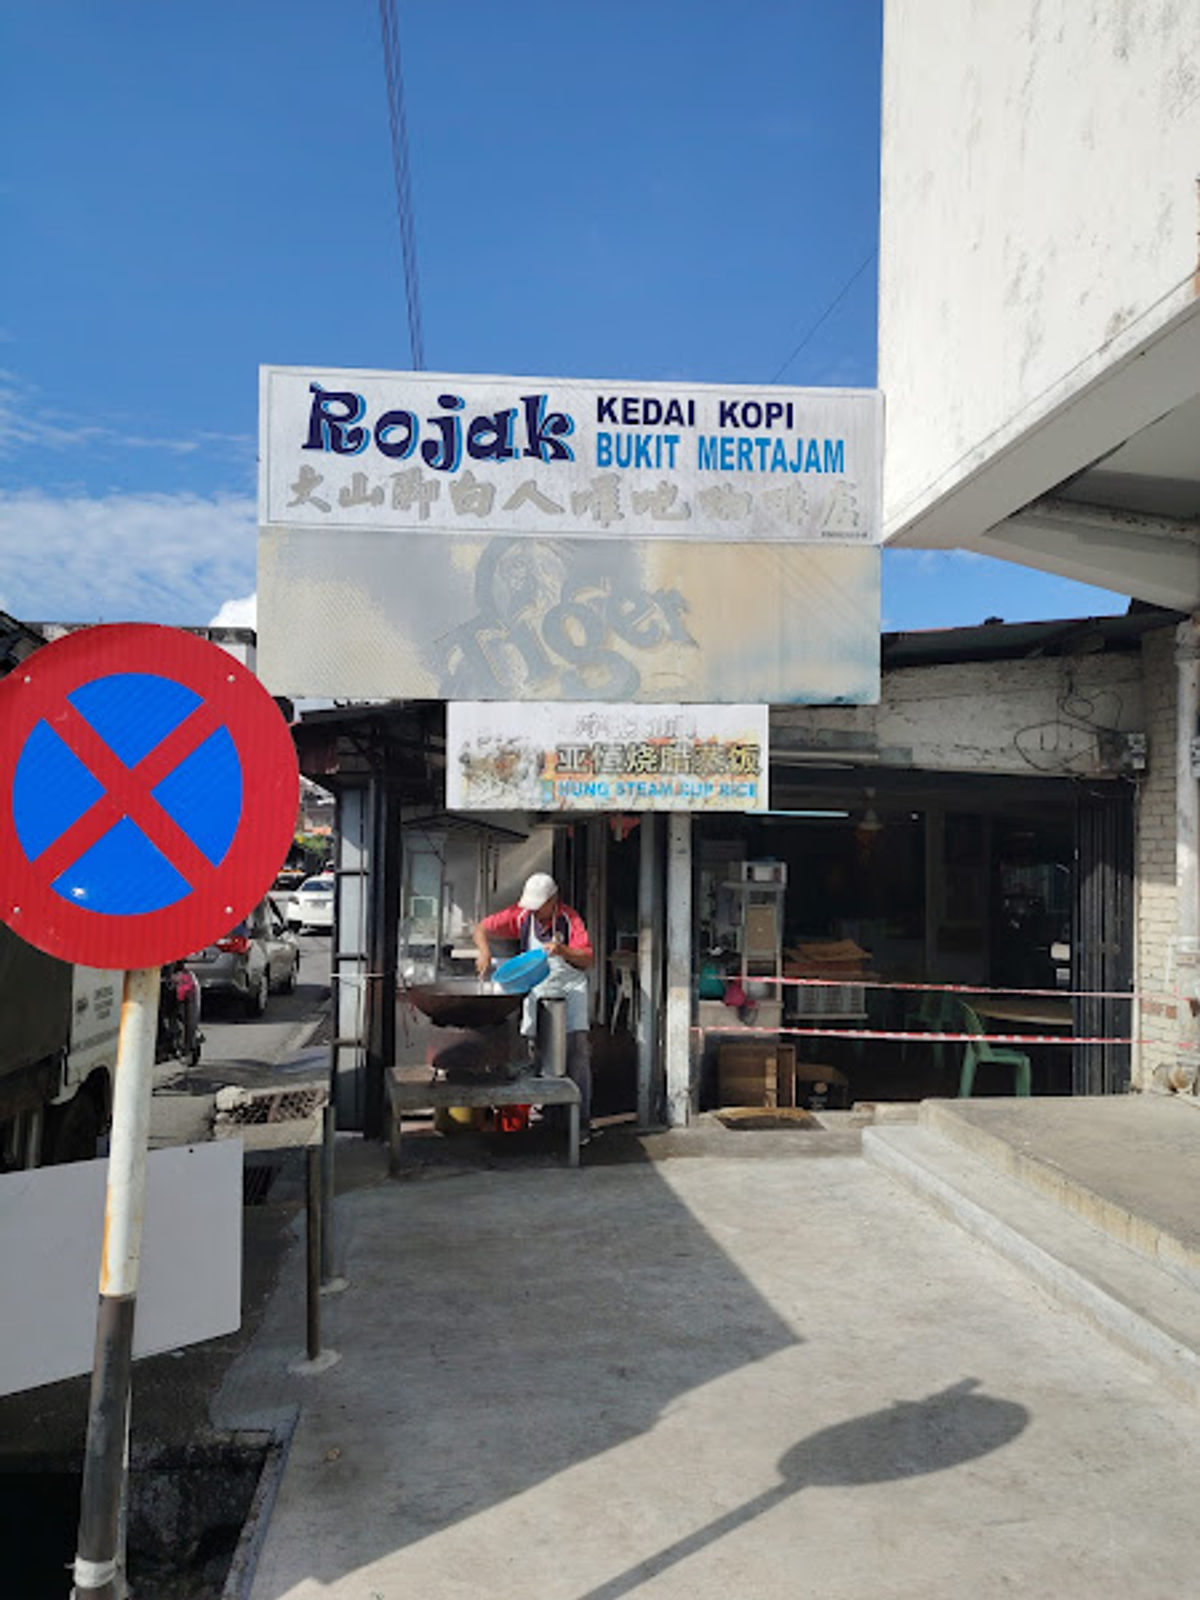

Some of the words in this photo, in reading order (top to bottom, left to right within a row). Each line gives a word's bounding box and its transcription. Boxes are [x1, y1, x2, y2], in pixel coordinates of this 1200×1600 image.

[302, 382, 576, 473] Rojak
[596, 396, 695, 426] KEDAI
[718, 401, 795, 429] KOPI
[596, 432, 681, 468] BUKIT
[699, 436, 845, 474] MERTAJAM
[617, 779, 674, 800] STEAM
